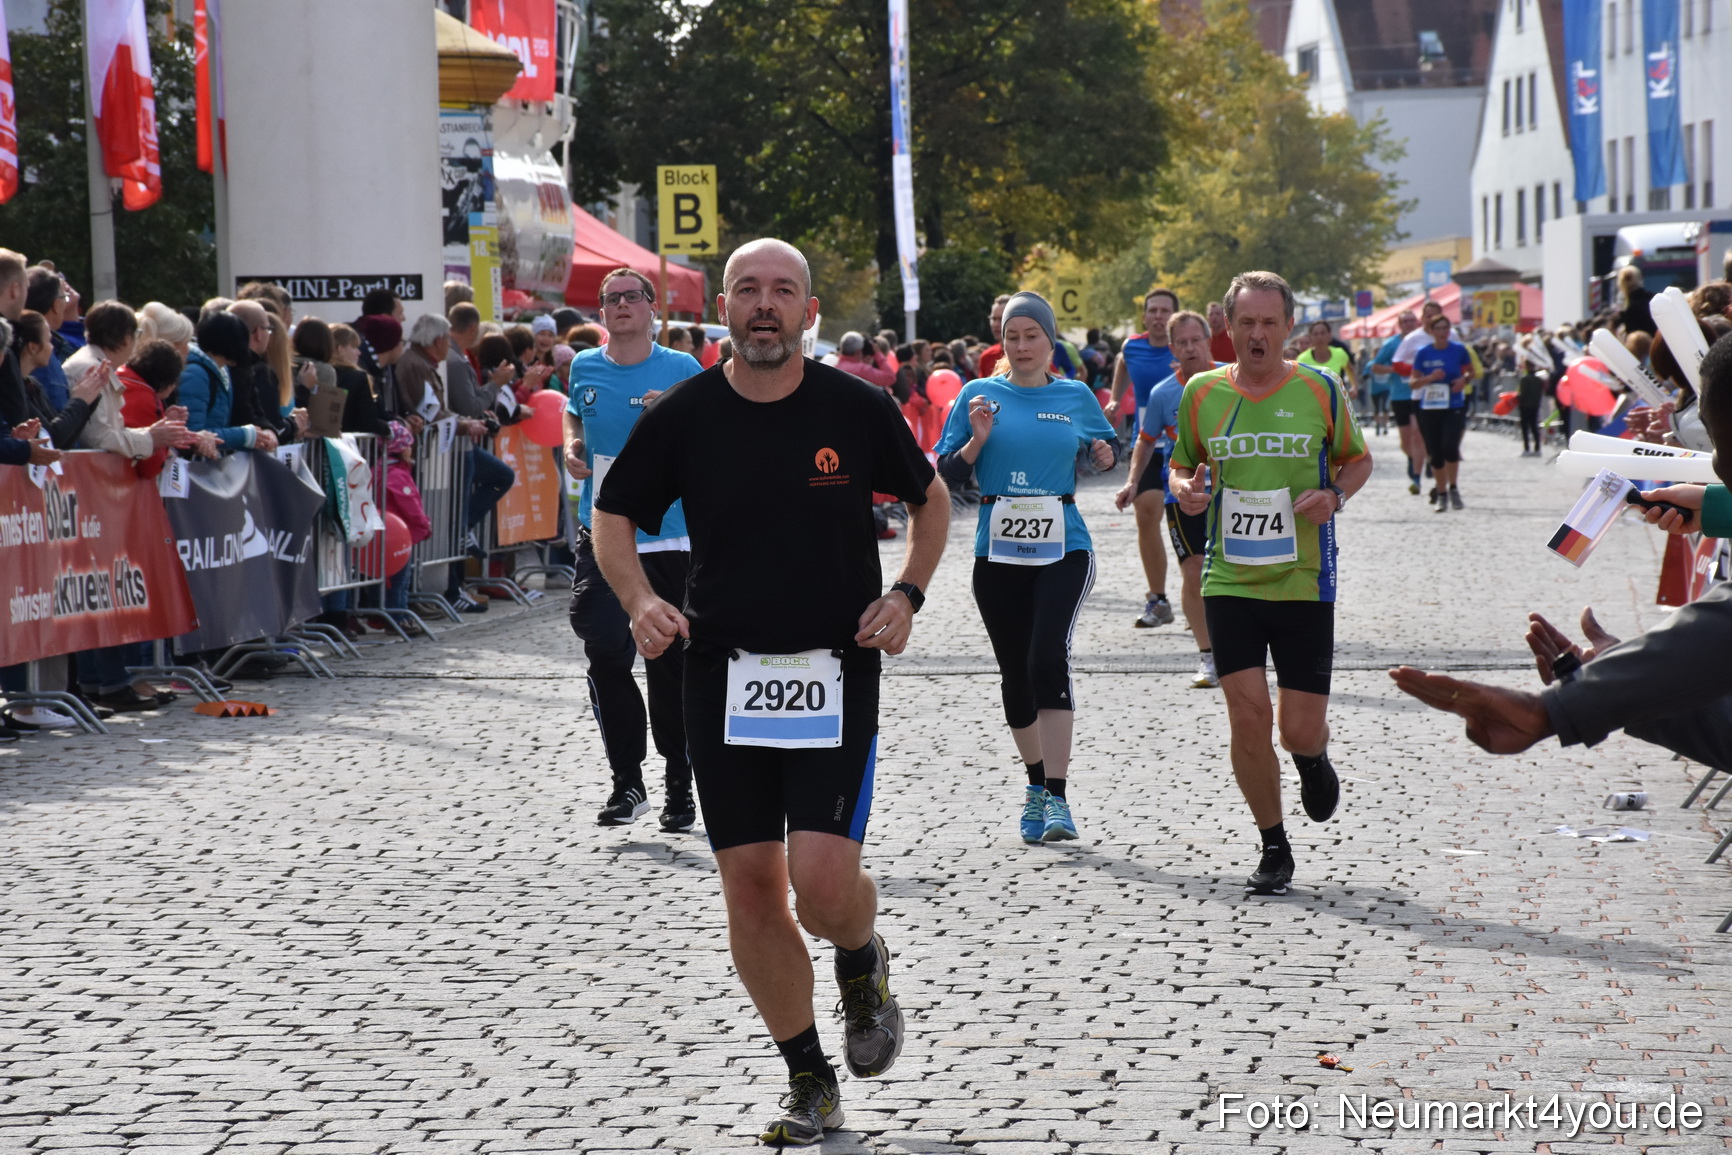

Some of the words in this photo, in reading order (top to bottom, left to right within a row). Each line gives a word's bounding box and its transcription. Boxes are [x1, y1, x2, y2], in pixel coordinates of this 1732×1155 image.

[1647, 41, 1671, 99] K&L
[664, 169, 709, 186] Block
[673, 193, 703, 235] B
[276, 278, 416, 299] MINI-Partlde
[1062, 289, 1078, 313] C
[1503, 300, 1516, 318] D
[1037, 412, 1071, 423] BOCK
[1208, 432, 1312, 460] BOCK
[1010, 471, 1029, 486] 18.
[1007, 485, 1049, 495] Neumarkter
[1001, 518, 1054, 539] 2237
[1231, 512, 1284, 536] 2774
[1017, 545, 1037, 554] Petra
[114, 555, 146, 608] Hits
[771, 657, 810, 666] BOCK
[744, 679, 826, 711] 2920
[833, 795, 845, 821] ACTIVE
